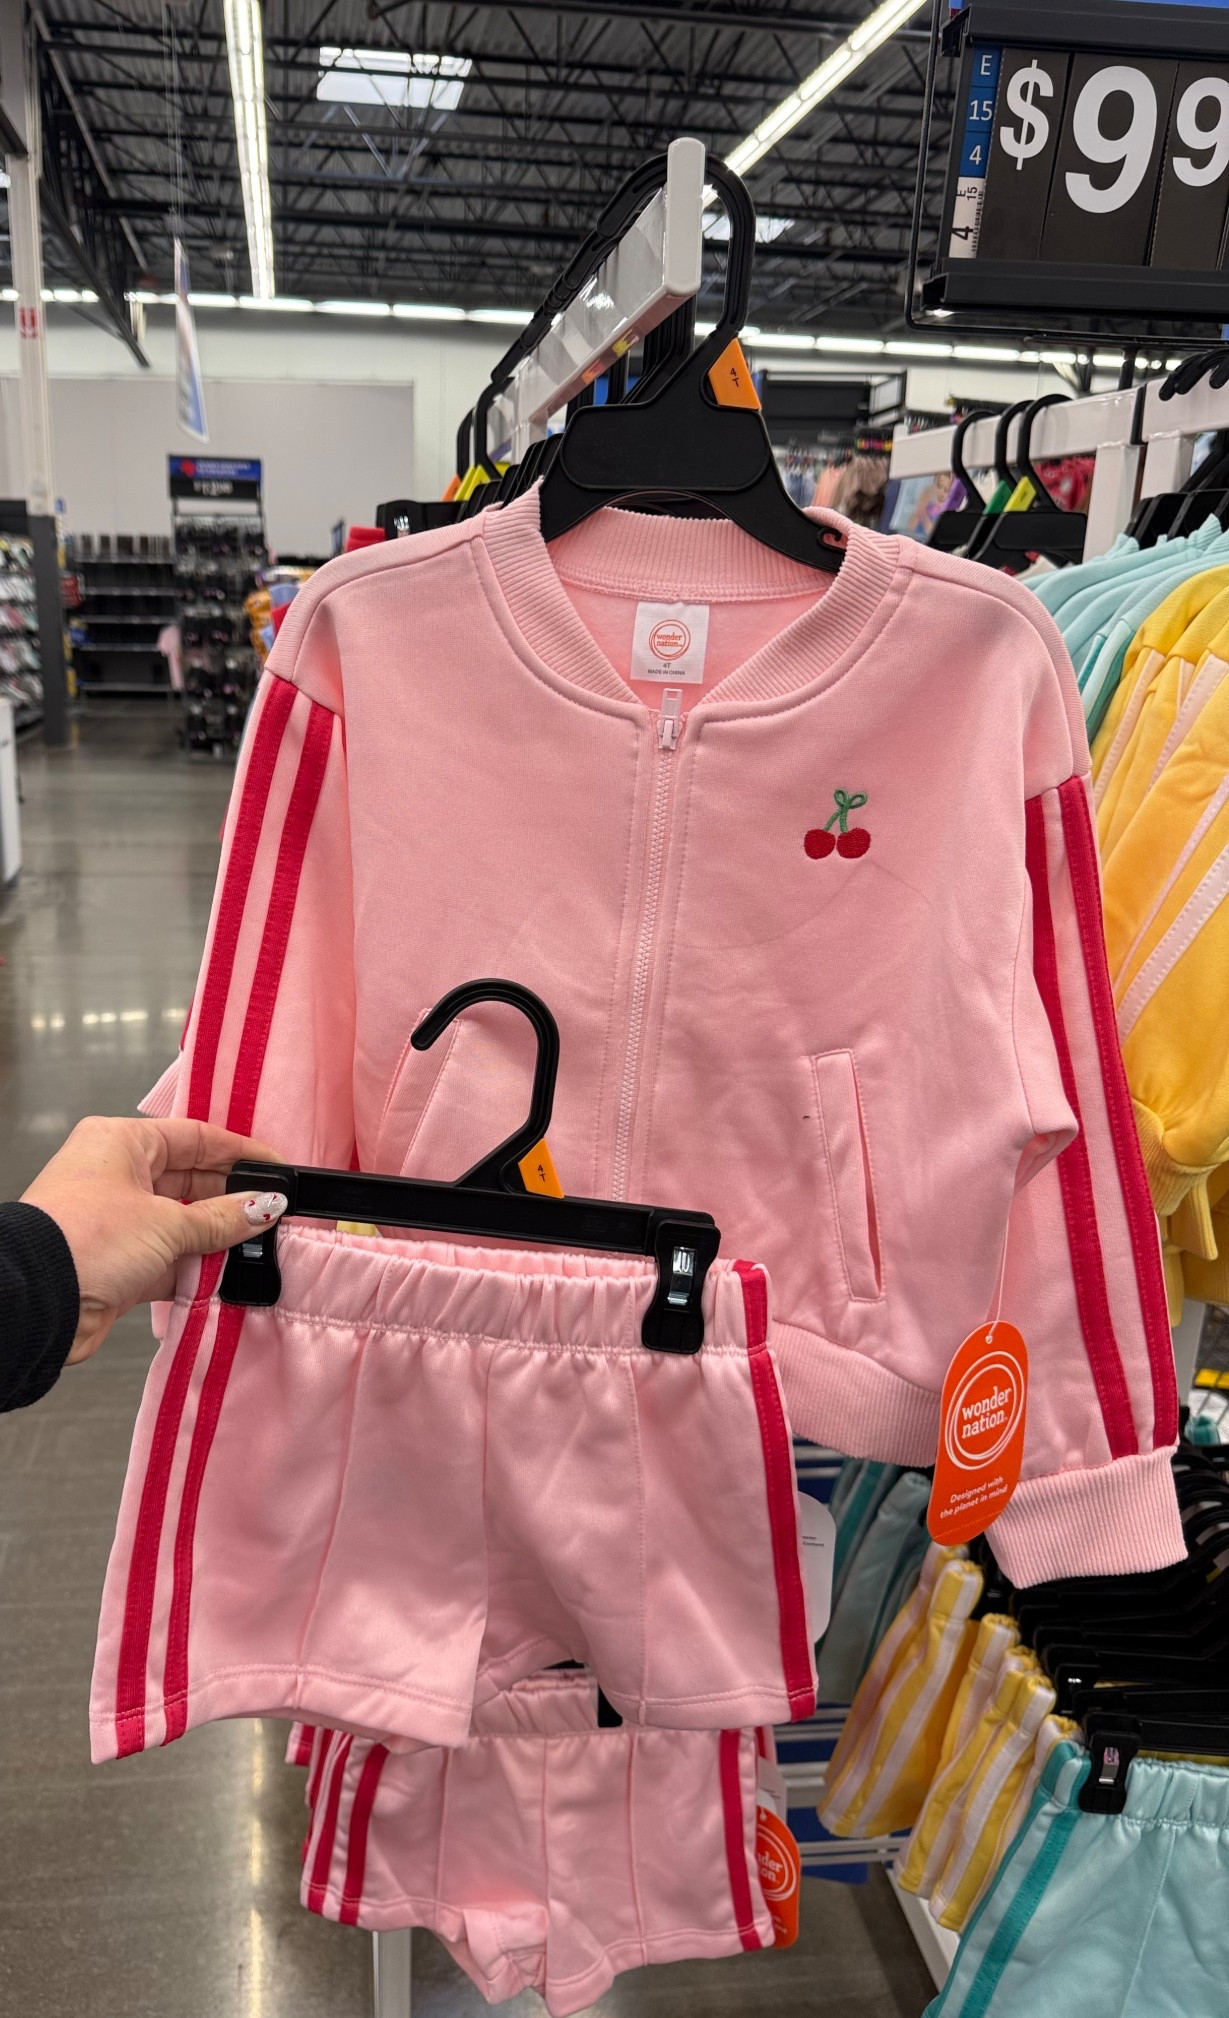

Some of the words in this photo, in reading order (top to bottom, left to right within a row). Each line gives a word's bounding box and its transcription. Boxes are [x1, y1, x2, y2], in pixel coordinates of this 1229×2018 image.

[980, 54, 993, 75] E
[968, 99, 993, 121] 15
[968, 144, 982, 166] 4
[966, 186, 978, 201] 15
[951, 225, 974, 241] 4
[656, 632, 683, 641] wonder
[961, 1385, 1013, 1421] wonder
[961, 1409, 1006, 1439] nation
[949, 1481, 988, 1504] Designed
[987, 1475, 1004, 1489] with
[939, 1508, 954, 1519] the
[953, 1497, 980, 1516] planet
[979, 1494, 988, 1503] in
[988, 1483, 1009, 1500] mind
[758, 1851, 783, 1873] der
